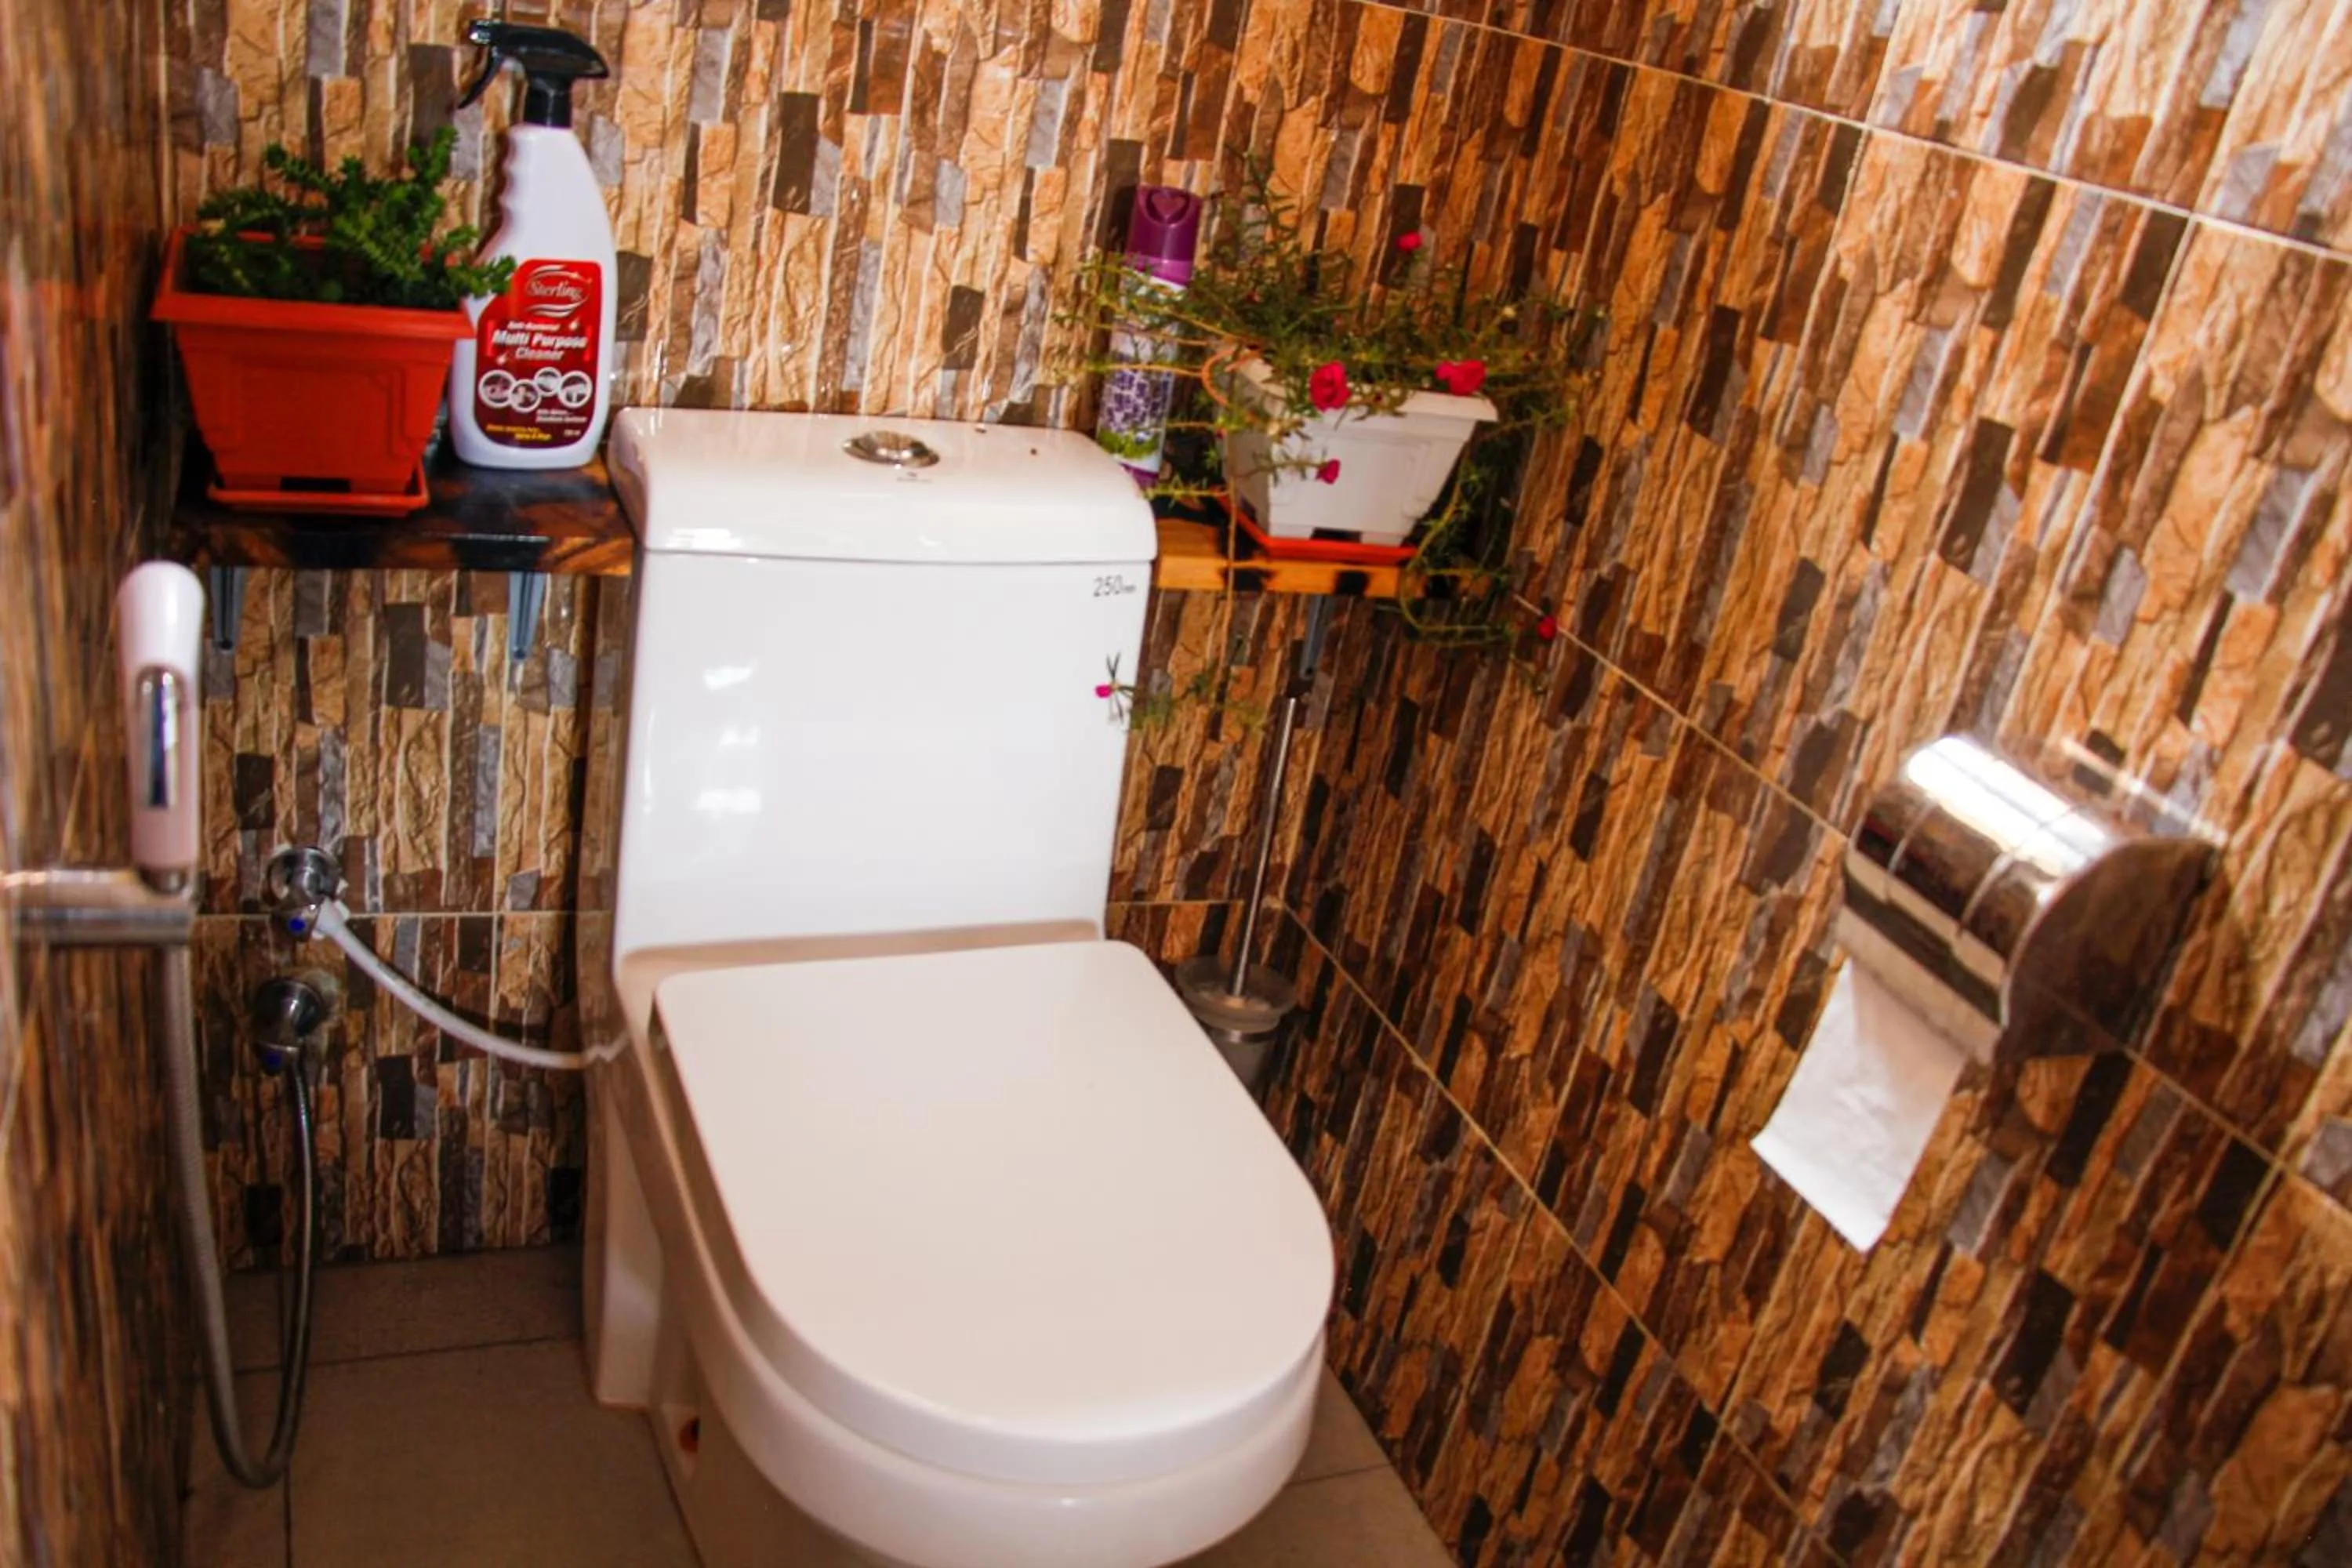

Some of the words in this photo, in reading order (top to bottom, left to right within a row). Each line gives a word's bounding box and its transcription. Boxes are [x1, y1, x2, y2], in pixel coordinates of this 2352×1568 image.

[529, 280, 583, 303] Sterling
[492, 329, 530, 346] Multi
[532, 332, 588, 349] Purpose
[515, 347, 564, 361] Cleaner
